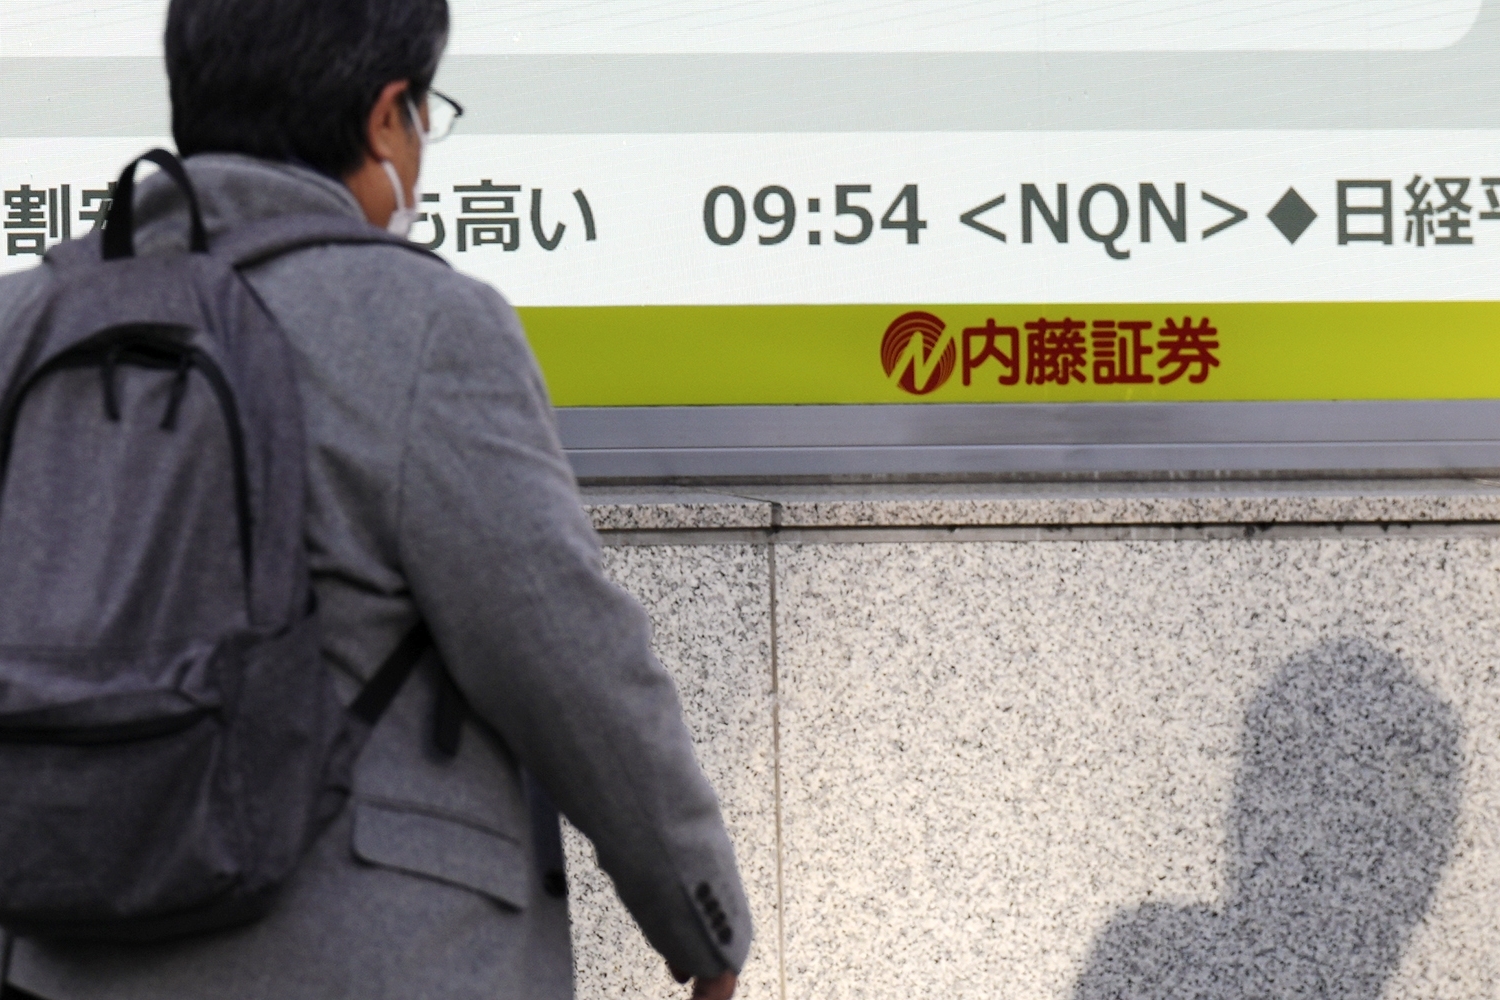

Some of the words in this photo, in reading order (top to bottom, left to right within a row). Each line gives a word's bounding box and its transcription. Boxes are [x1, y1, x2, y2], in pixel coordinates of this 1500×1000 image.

[704, 185, 927, 246] 09:54
[961, 316, 1220, 387] 内藤証券
